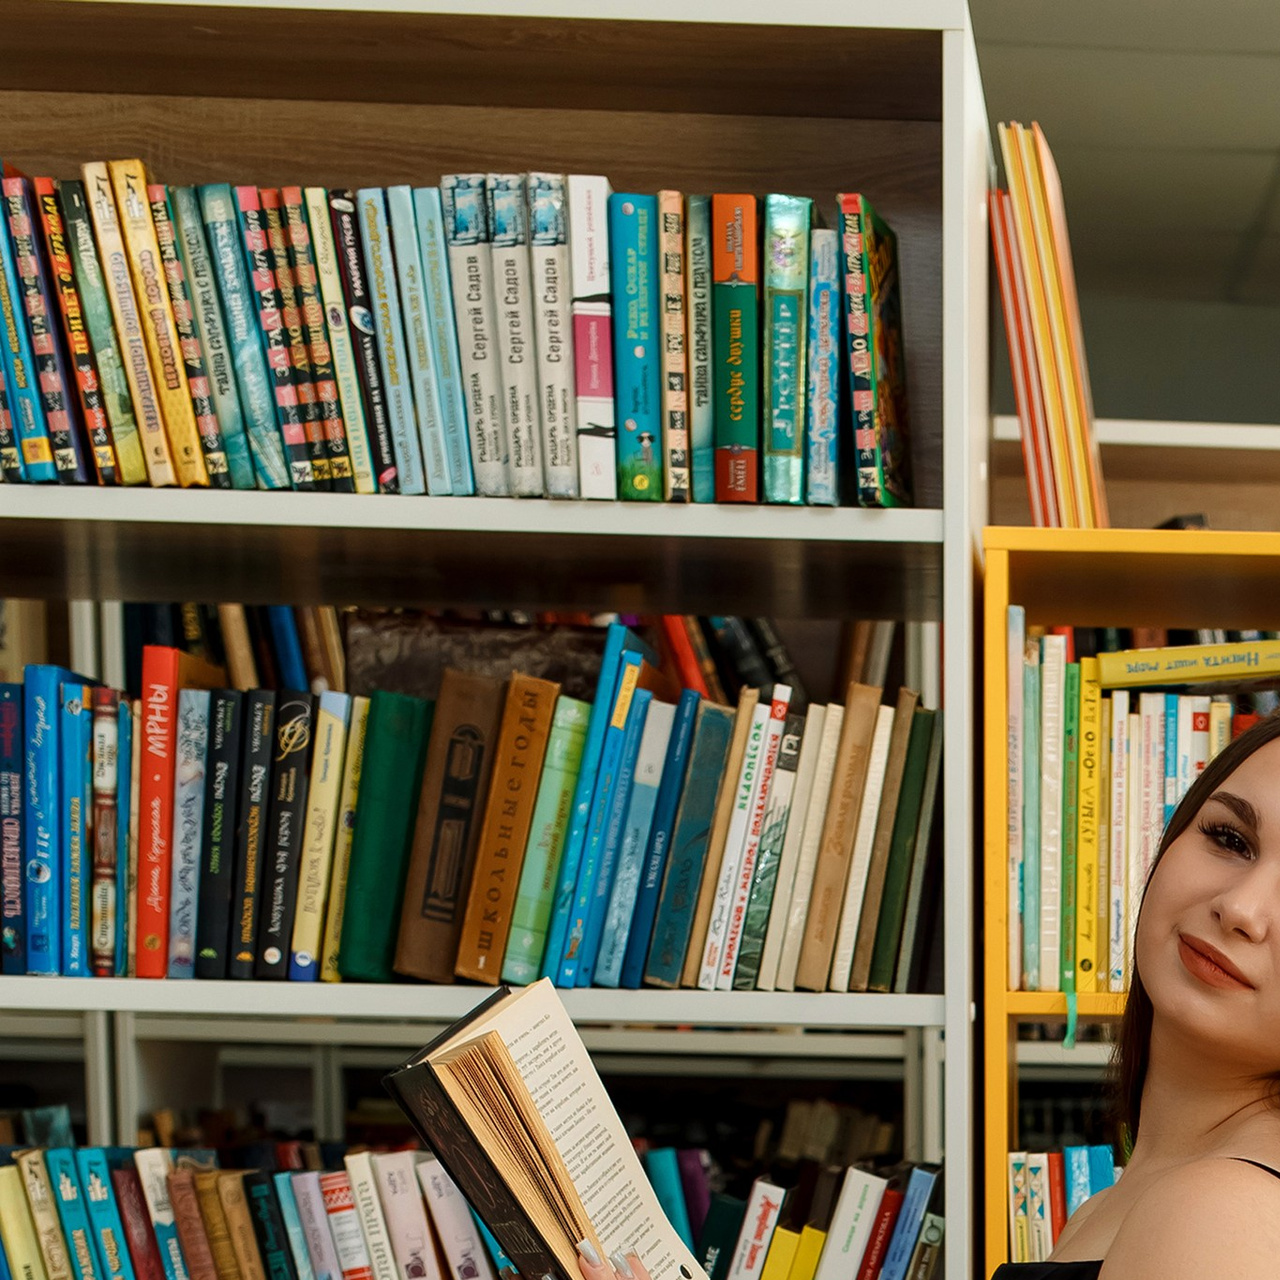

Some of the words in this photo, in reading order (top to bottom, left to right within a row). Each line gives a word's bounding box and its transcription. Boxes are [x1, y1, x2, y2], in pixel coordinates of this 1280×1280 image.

[342, 214, 355, 246] ГУСЕВ
[349, 248, 364, 297] ВАЛЕРИЙ
[466, 256, 480, 302] Садов
[504, 260, 518, 305] Садов
[543, 258, 557, 304] Садов
[63, 286, 88, 354] ПРИВЕТ
[261, 288, 290, 377] ЗАГАДКА
[467, 307, 487, 360] Сергей
[505, 310, 525, 364] Сергей
[543, 310, 562, 362] Сергей
[854, 340, 870, 378] ДЕЛО
[729, 370, 744, 421] сердце
[147, 684, 169, 758] МРНЫ
[477, 778, 520, 951] ШКОЛЬНЫЕ
[512, 691, 540, 767] ГОДЫ
